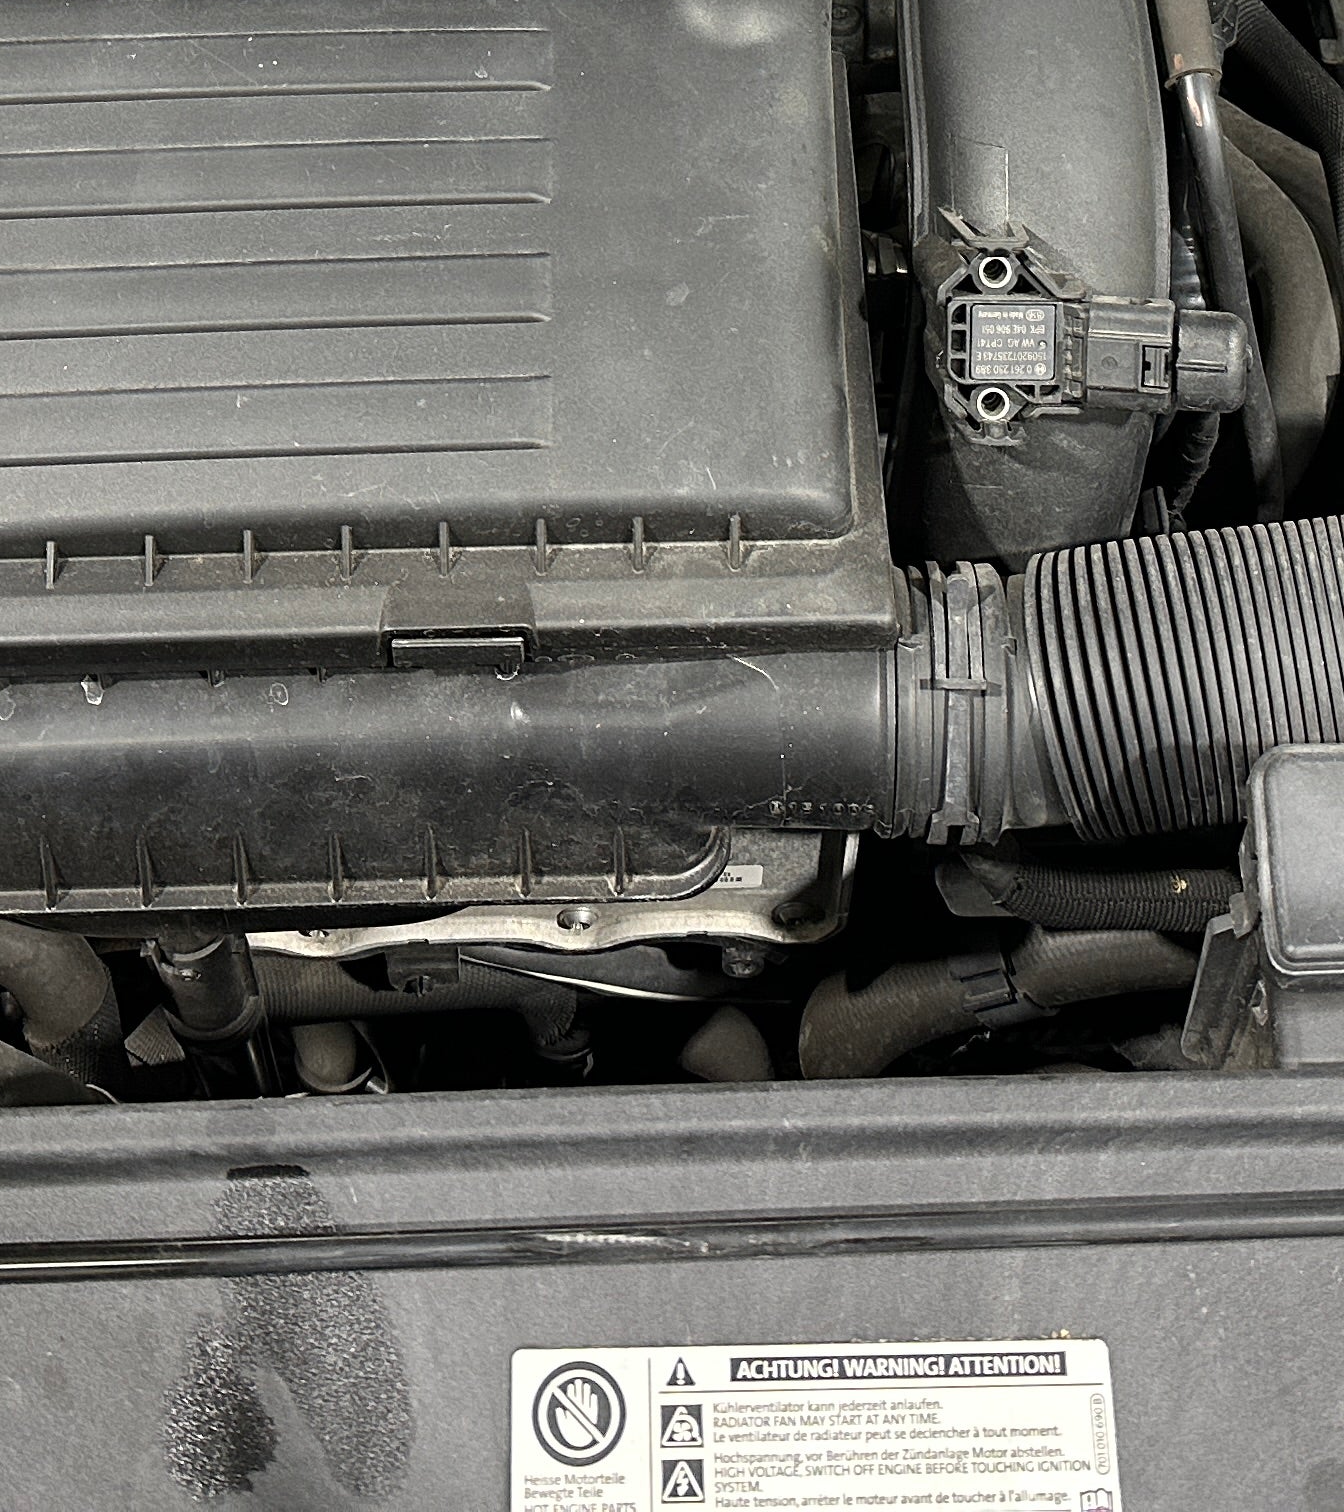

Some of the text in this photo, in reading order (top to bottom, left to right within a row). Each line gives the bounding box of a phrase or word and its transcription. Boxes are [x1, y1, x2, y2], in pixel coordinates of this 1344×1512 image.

[736, 1355, 1061, 1379] ACHTUNG! WARNING! ATTENTION!
[713, 1400, 805, 1413] Kühlerventilator
[807, 1401, 836, 1412] kann
[838, 1400, 887, 1415] jederzeit
[713, 1416, 770, 1428] RADIATOR
[774, 1415, 796, 1427] FAN
[800, 1415, 826, 1426] MAY
[829, 1414, 863, 1426] START
[866, 1414, 879, 1425] AT
[882, 1414, 906, 1425] ANY
[1093, 1407, 1104, 1429] 690
[713, 1432, 726, 1443] Le
[729, 1431, 790, 1443] ventilateur
[793, 1430, 807, 1442] de
[810, 1429, 862, 1441] radiateur
[865, 1429, 891, 1444] peut
[894, 1430, 907, 1440] se
[973, 1426, 980, 1438] à
[982, 1427, 1007, 1438] tout
[1095, 1431, 1105, 1450] 010
[806, 1452, 823, 1462] vor
[827, 1450, 878, 1461] Berühren
[881, 1449, 899, 1461] der
[902, 1448, 969, 1463] Zündanlage
[972, 1447, 1008, 1459] Motor
[714, 1466, 745, 1478] HIGH
[805, 1465, 850, 1476] SWITCH
[853, 1464, 875, 1476] OFF
[878, 1463, 921, 1475] ENGINE
[925, 1462, 969, 1474] BEFORE
[970, 1461, 1035, 1473] TOUCHING
[1037, 1460, 1091, 1472] IGNITION
[564, 1472, 625, 1485] Motorteile
[524, 1486, 604, 1502] Bewegte Teile
[715, 1496, 750, 1508] Haute
[843, 1493, 853, 1505] le
[855, 1494, 898, 1505] moteur
[900, 1493, 933, 1504] avant
[935, 1492, 949, 1504] de
[951, 1491, 996, 1504] toucher
[999, 1490, 1006, 1503] à
[553, 1504, 597, 1512] ENGINE
[601, 1502, 636, 1512] PARTS
